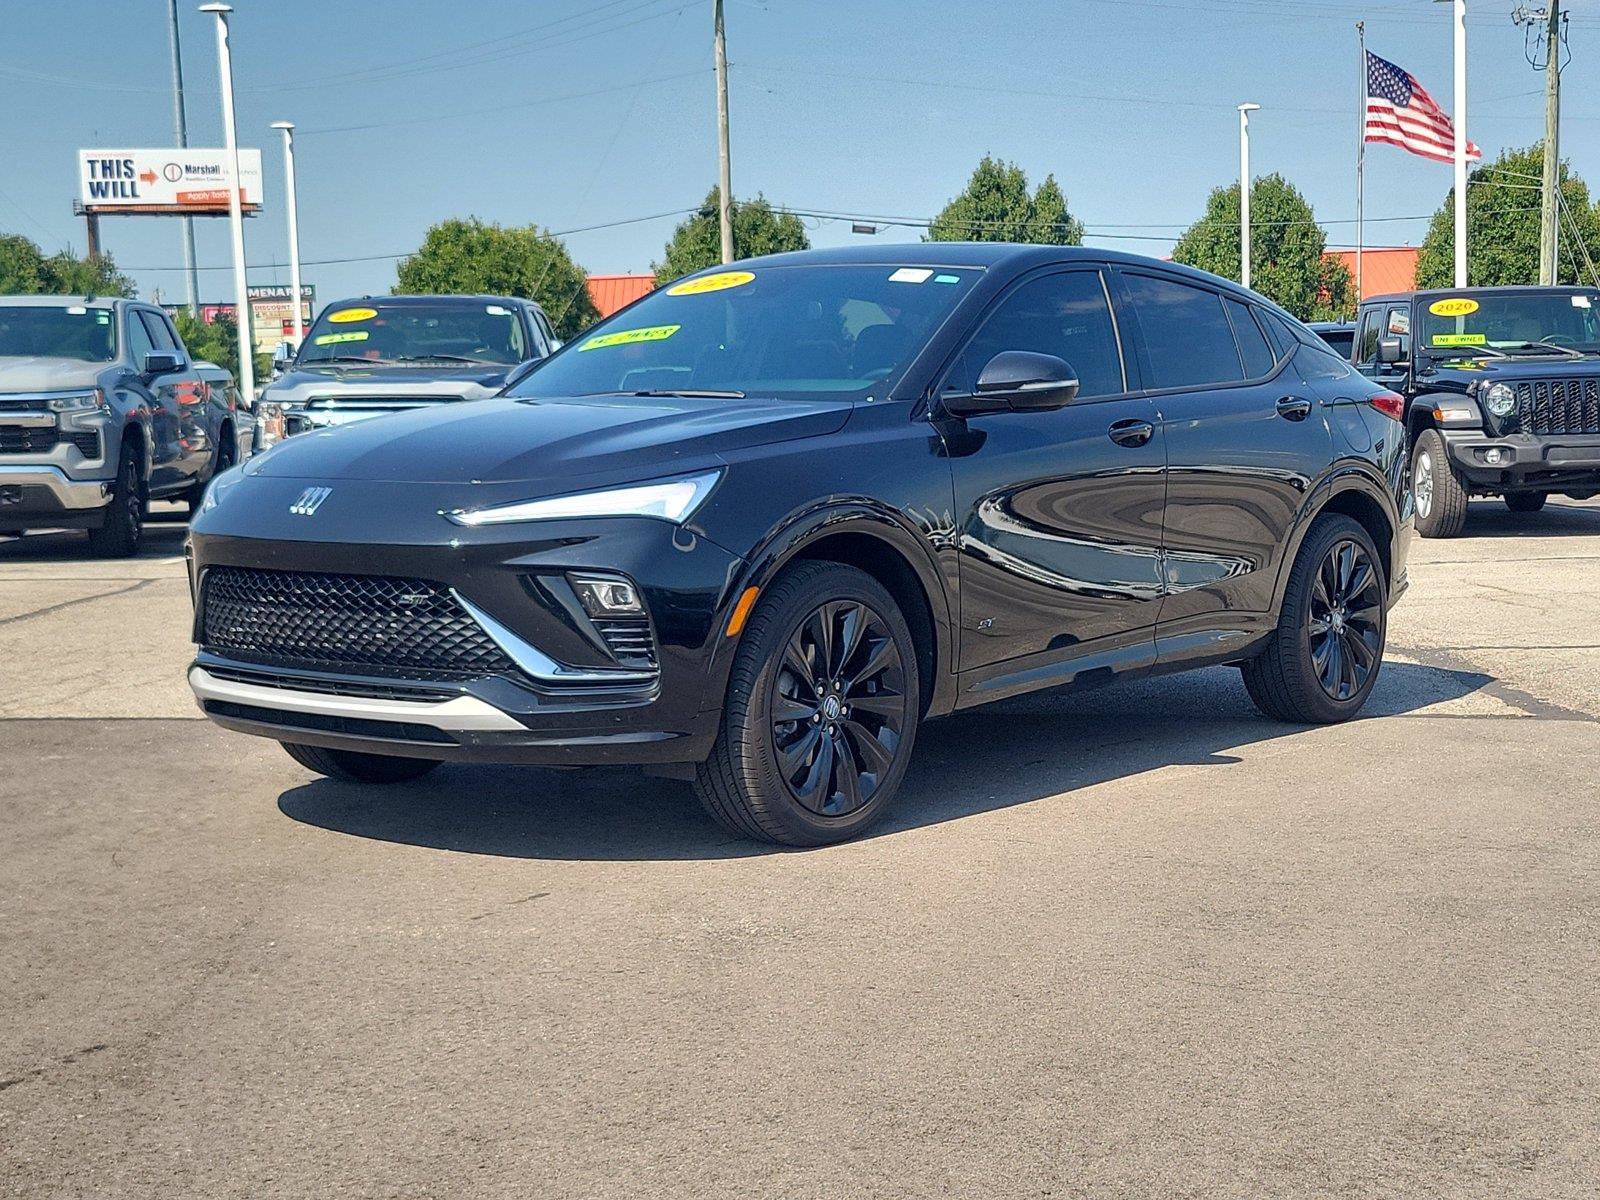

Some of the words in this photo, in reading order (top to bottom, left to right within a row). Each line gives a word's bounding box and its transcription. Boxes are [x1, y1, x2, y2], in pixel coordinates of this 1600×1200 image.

[87, 159, 136, 179] THIS
[184, 164, 221, 175] Marshall
[88, 181, 141, 199] WILL
[187, 191, 210, 201] Apply
[211, 189, 232, 200] Toda
[1436, 302, 1473, 313] 2020
[1454, 335, 1484, 344] OWNER
